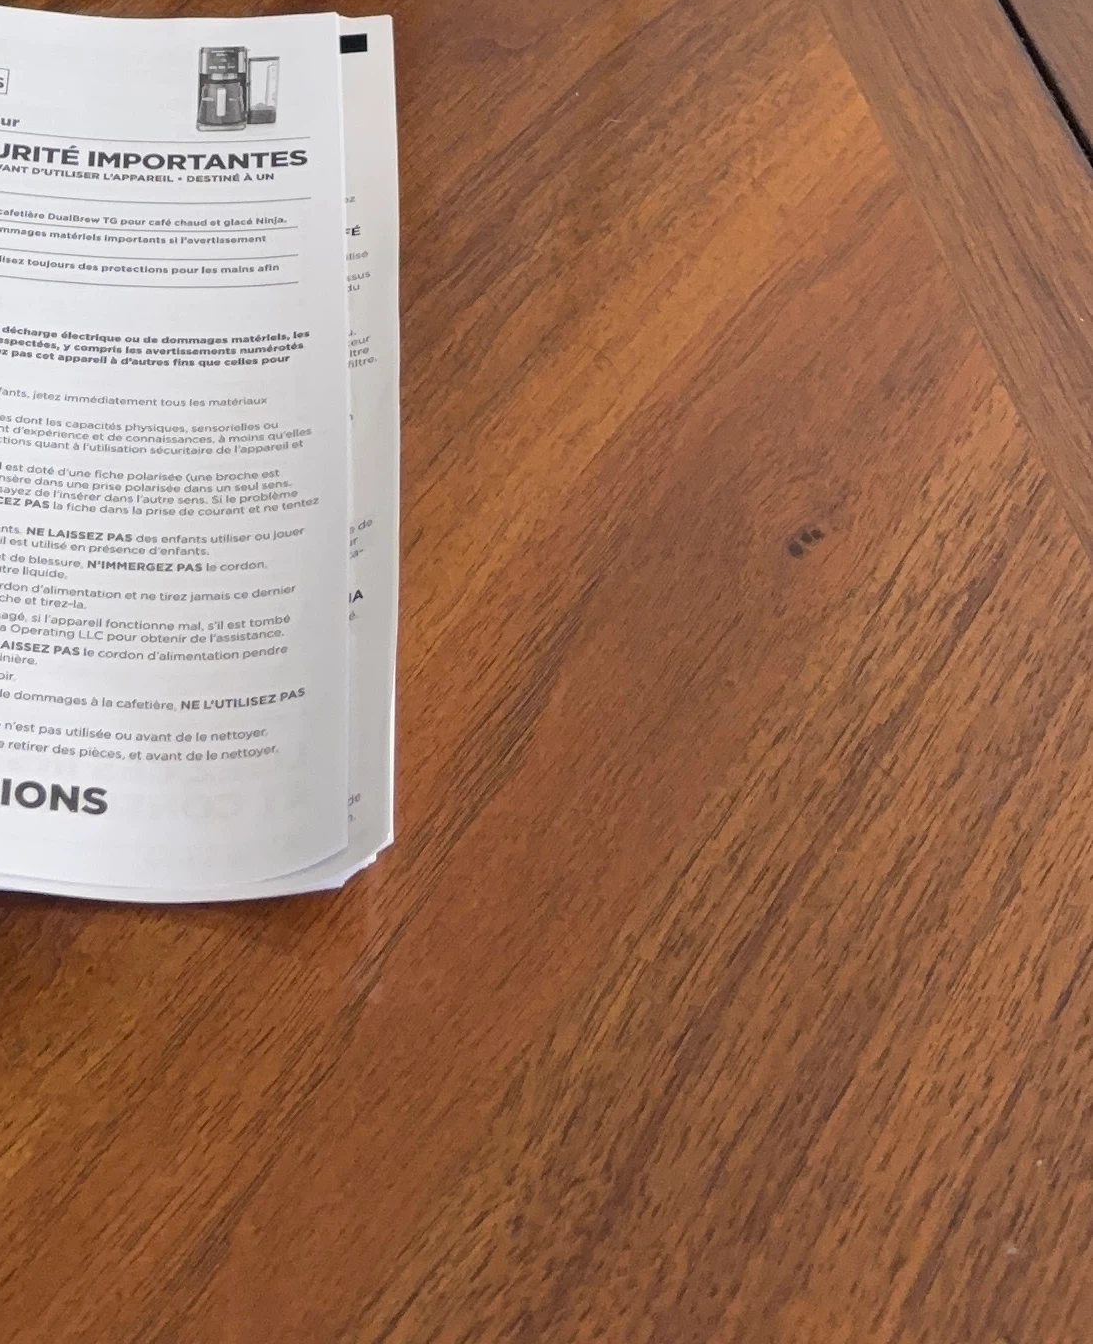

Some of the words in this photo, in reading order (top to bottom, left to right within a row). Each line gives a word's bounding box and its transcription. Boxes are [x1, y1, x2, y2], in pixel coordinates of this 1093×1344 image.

[88, 150, 308, 170] IMPORTANTES
[31, 167, 100, 180] D'UTILISER
[103, 173, 174, 183] L'APPAREIL
[186, 172, 240, 183] DESTINÉ
[243, 172, 253, 182] À
[256, 173, 274, 181] UN
[47, 212, 100, 224] DualBrew
[103, 216, 118, 225] TG
[148, 218, 172, 227] café
[174, 219, 207, 227] chaud
[223, 217, 253, 228] glacé
[255, 216, 287, 225] Ninja.
[4, 720, 35, 733] n'est
[38, 726, 62, 736] pas
[65, 727, 112, 740] utilisée
[115, 732, 132, 741] ou
[135, 732, 172, 742] avant
[175, 732, 193, 743] de
[195, 732, 207, 742] le
[210, 728, 268, 741] nettoyer.
[8, 740, 49, 753] retirer
[51, 744, 76, 756] des
[79, 746, 125, 759] pièces,
[128, 750, 142, 761] et
[145, 752, 182, 762] avant
[185, 750, 203, 762] de
[206, 750, 218, 761] le
[221, 746, 279, 760] nettoyer.
